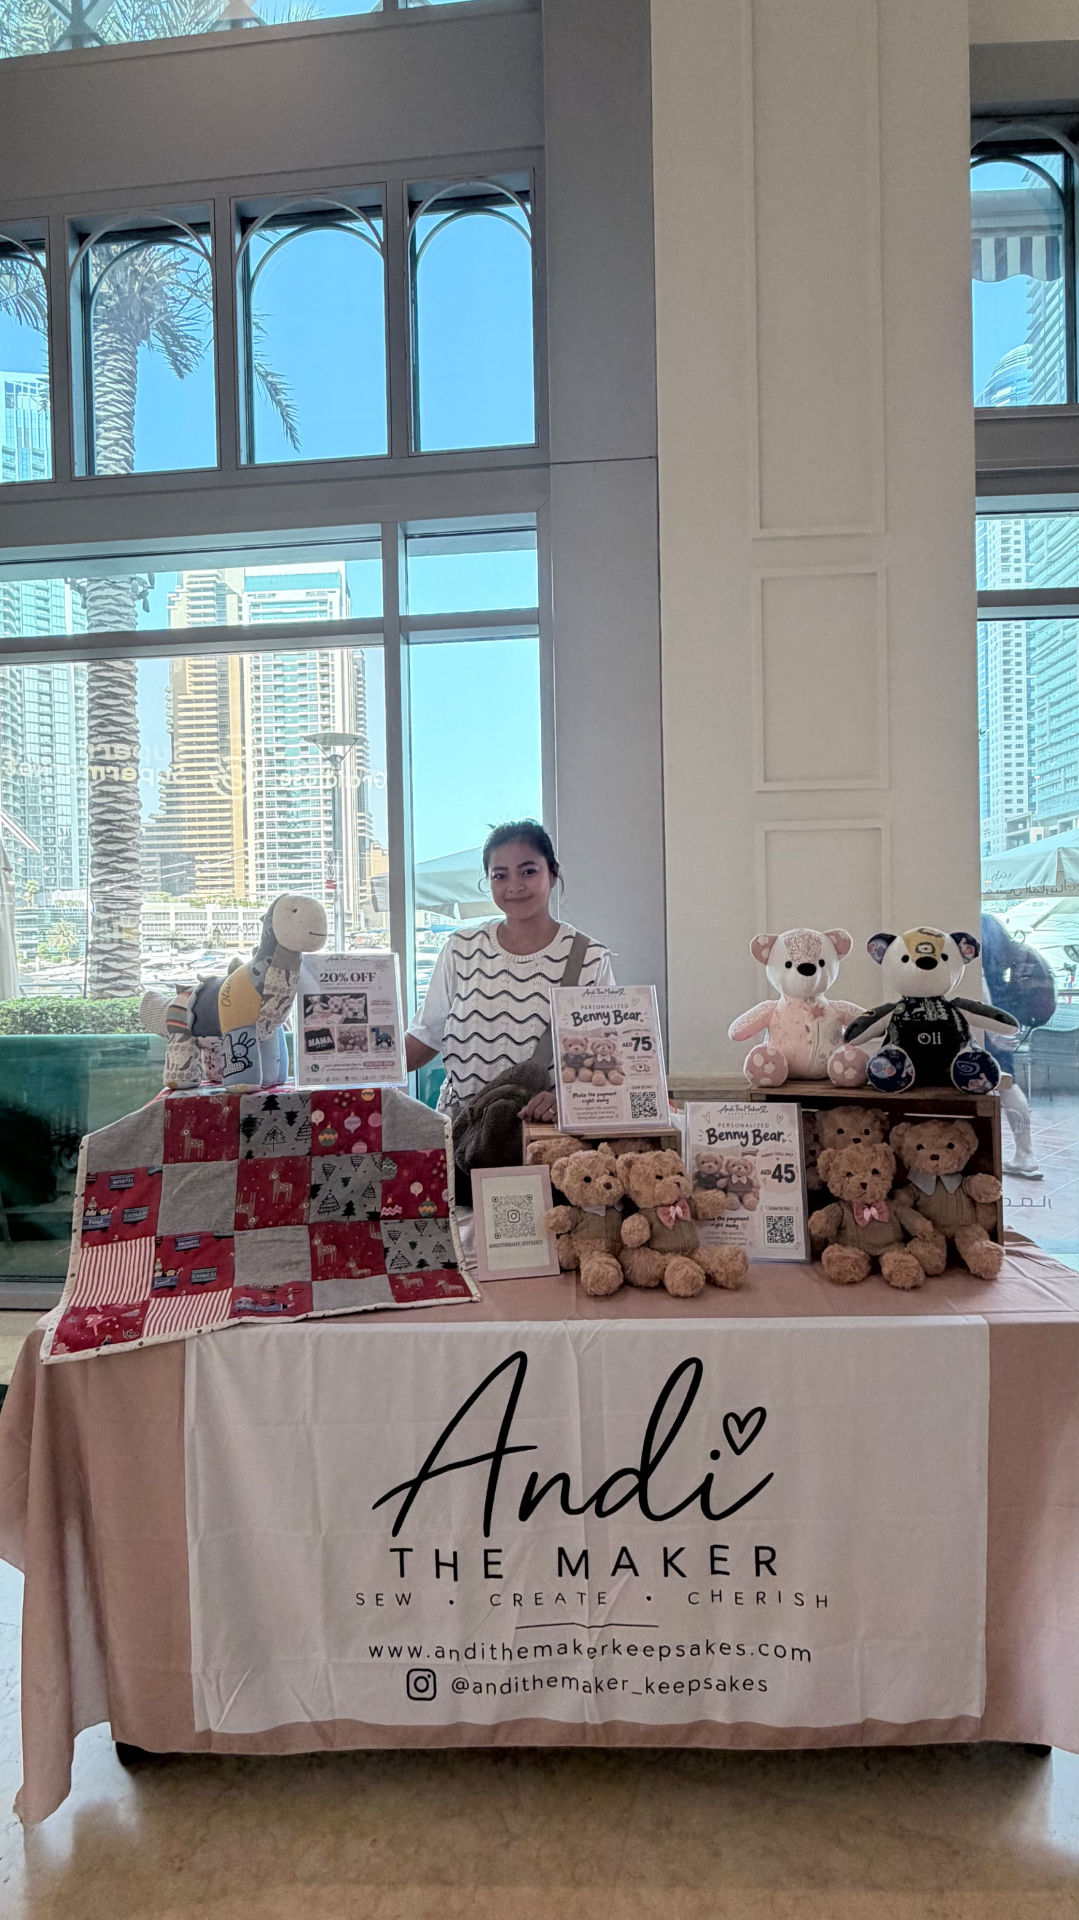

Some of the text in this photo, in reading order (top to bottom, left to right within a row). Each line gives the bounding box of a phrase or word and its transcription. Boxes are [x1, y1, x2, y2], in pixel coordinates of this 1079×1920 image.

[319, 972, 377, 983] 20% OFF
[571, 1010, 641, 1026] Benny Bear
[631, 1036, 652, 1052] 75
[917, 1032, 942, 1045] Oli
[581, 1098, 595, 1106] right
[597, 1091, 617, 1099] payment
[705, 1128, 784, 1147] Benny Bear
[771, 1163, 796, 1183] 45
[372, 1350, 774, 1538] Andi
[389, 1544, 778, 1582] THE MAKER
[356, 1589, 829, 1609] SEW CREATE CHERISH
[368, 1638, 812, 1663] www.andithemakerkeepsakes.com
[451, 1674, 768, 1697] @andithemaker_keepsakes
